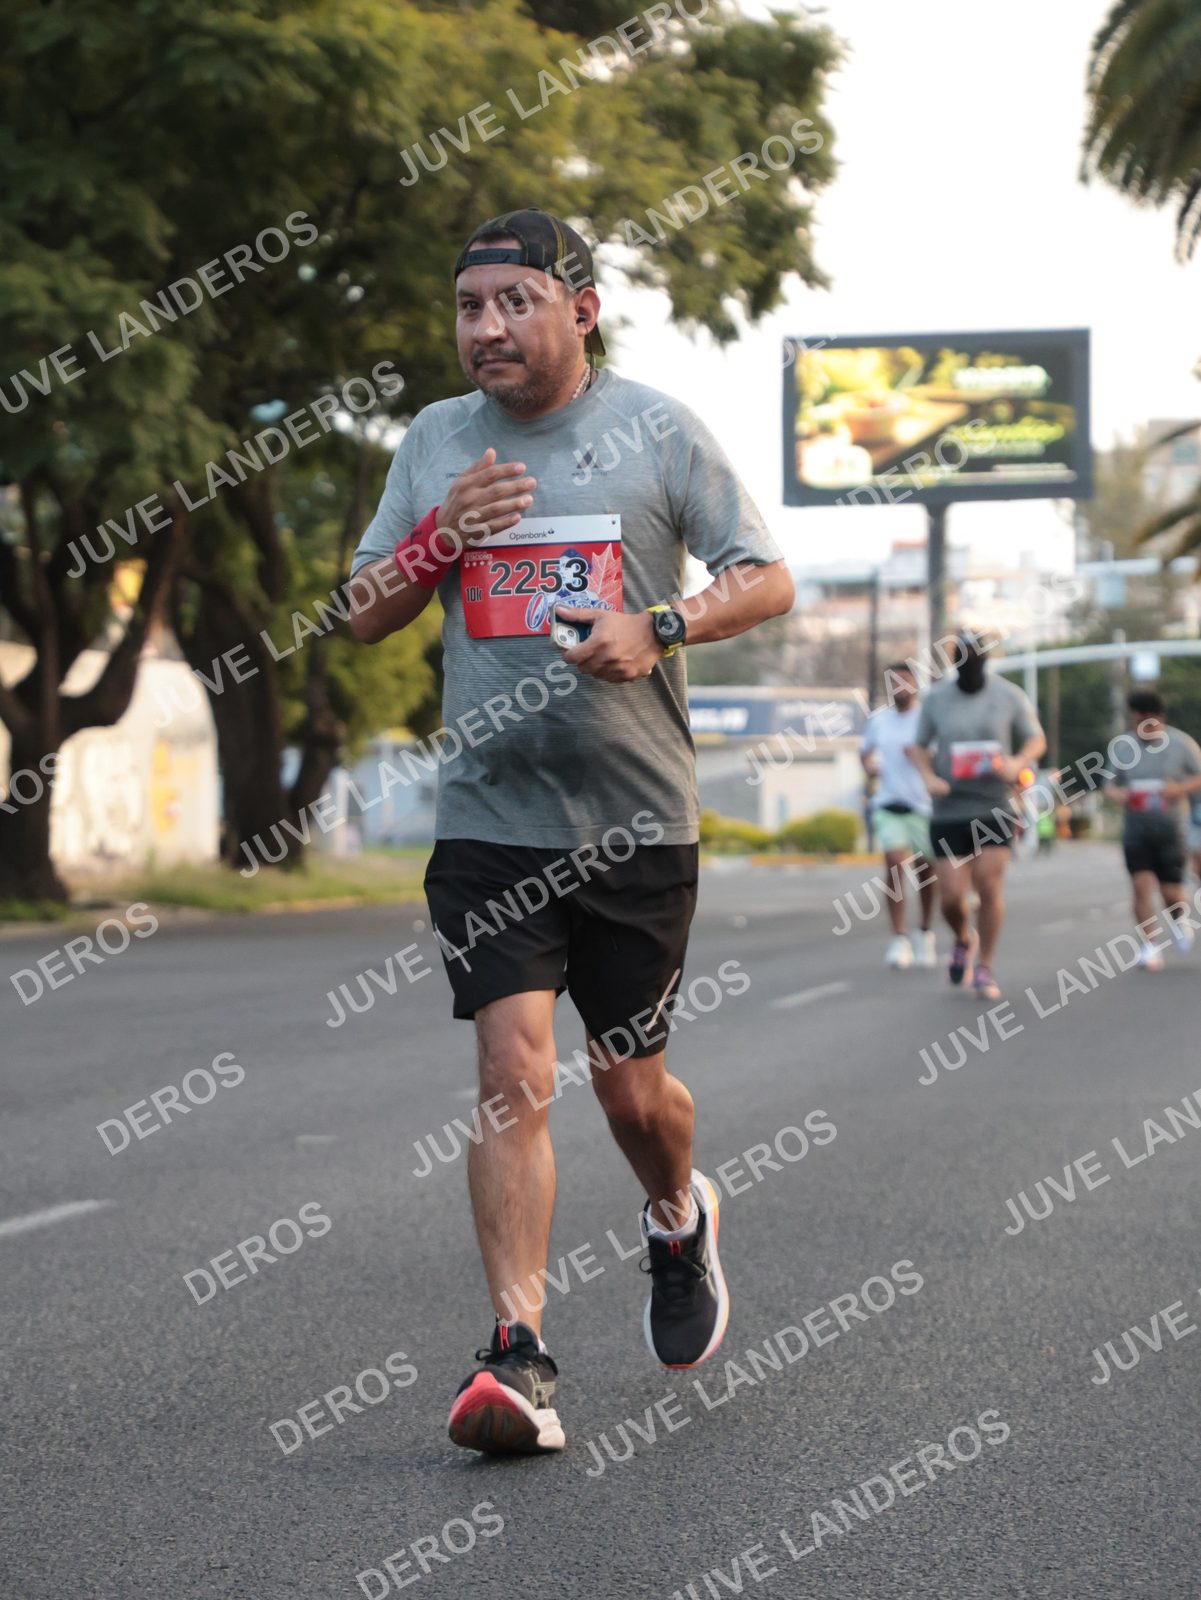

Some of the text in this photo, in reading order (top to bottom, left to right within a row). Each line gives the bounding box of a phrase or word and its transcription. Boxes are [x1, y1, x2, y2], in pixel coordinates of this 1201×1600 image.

[509, 529, 548, 541] Openbank
[489, 556, 589, 597] 2253
[465, 586, 483, 603] 10k
